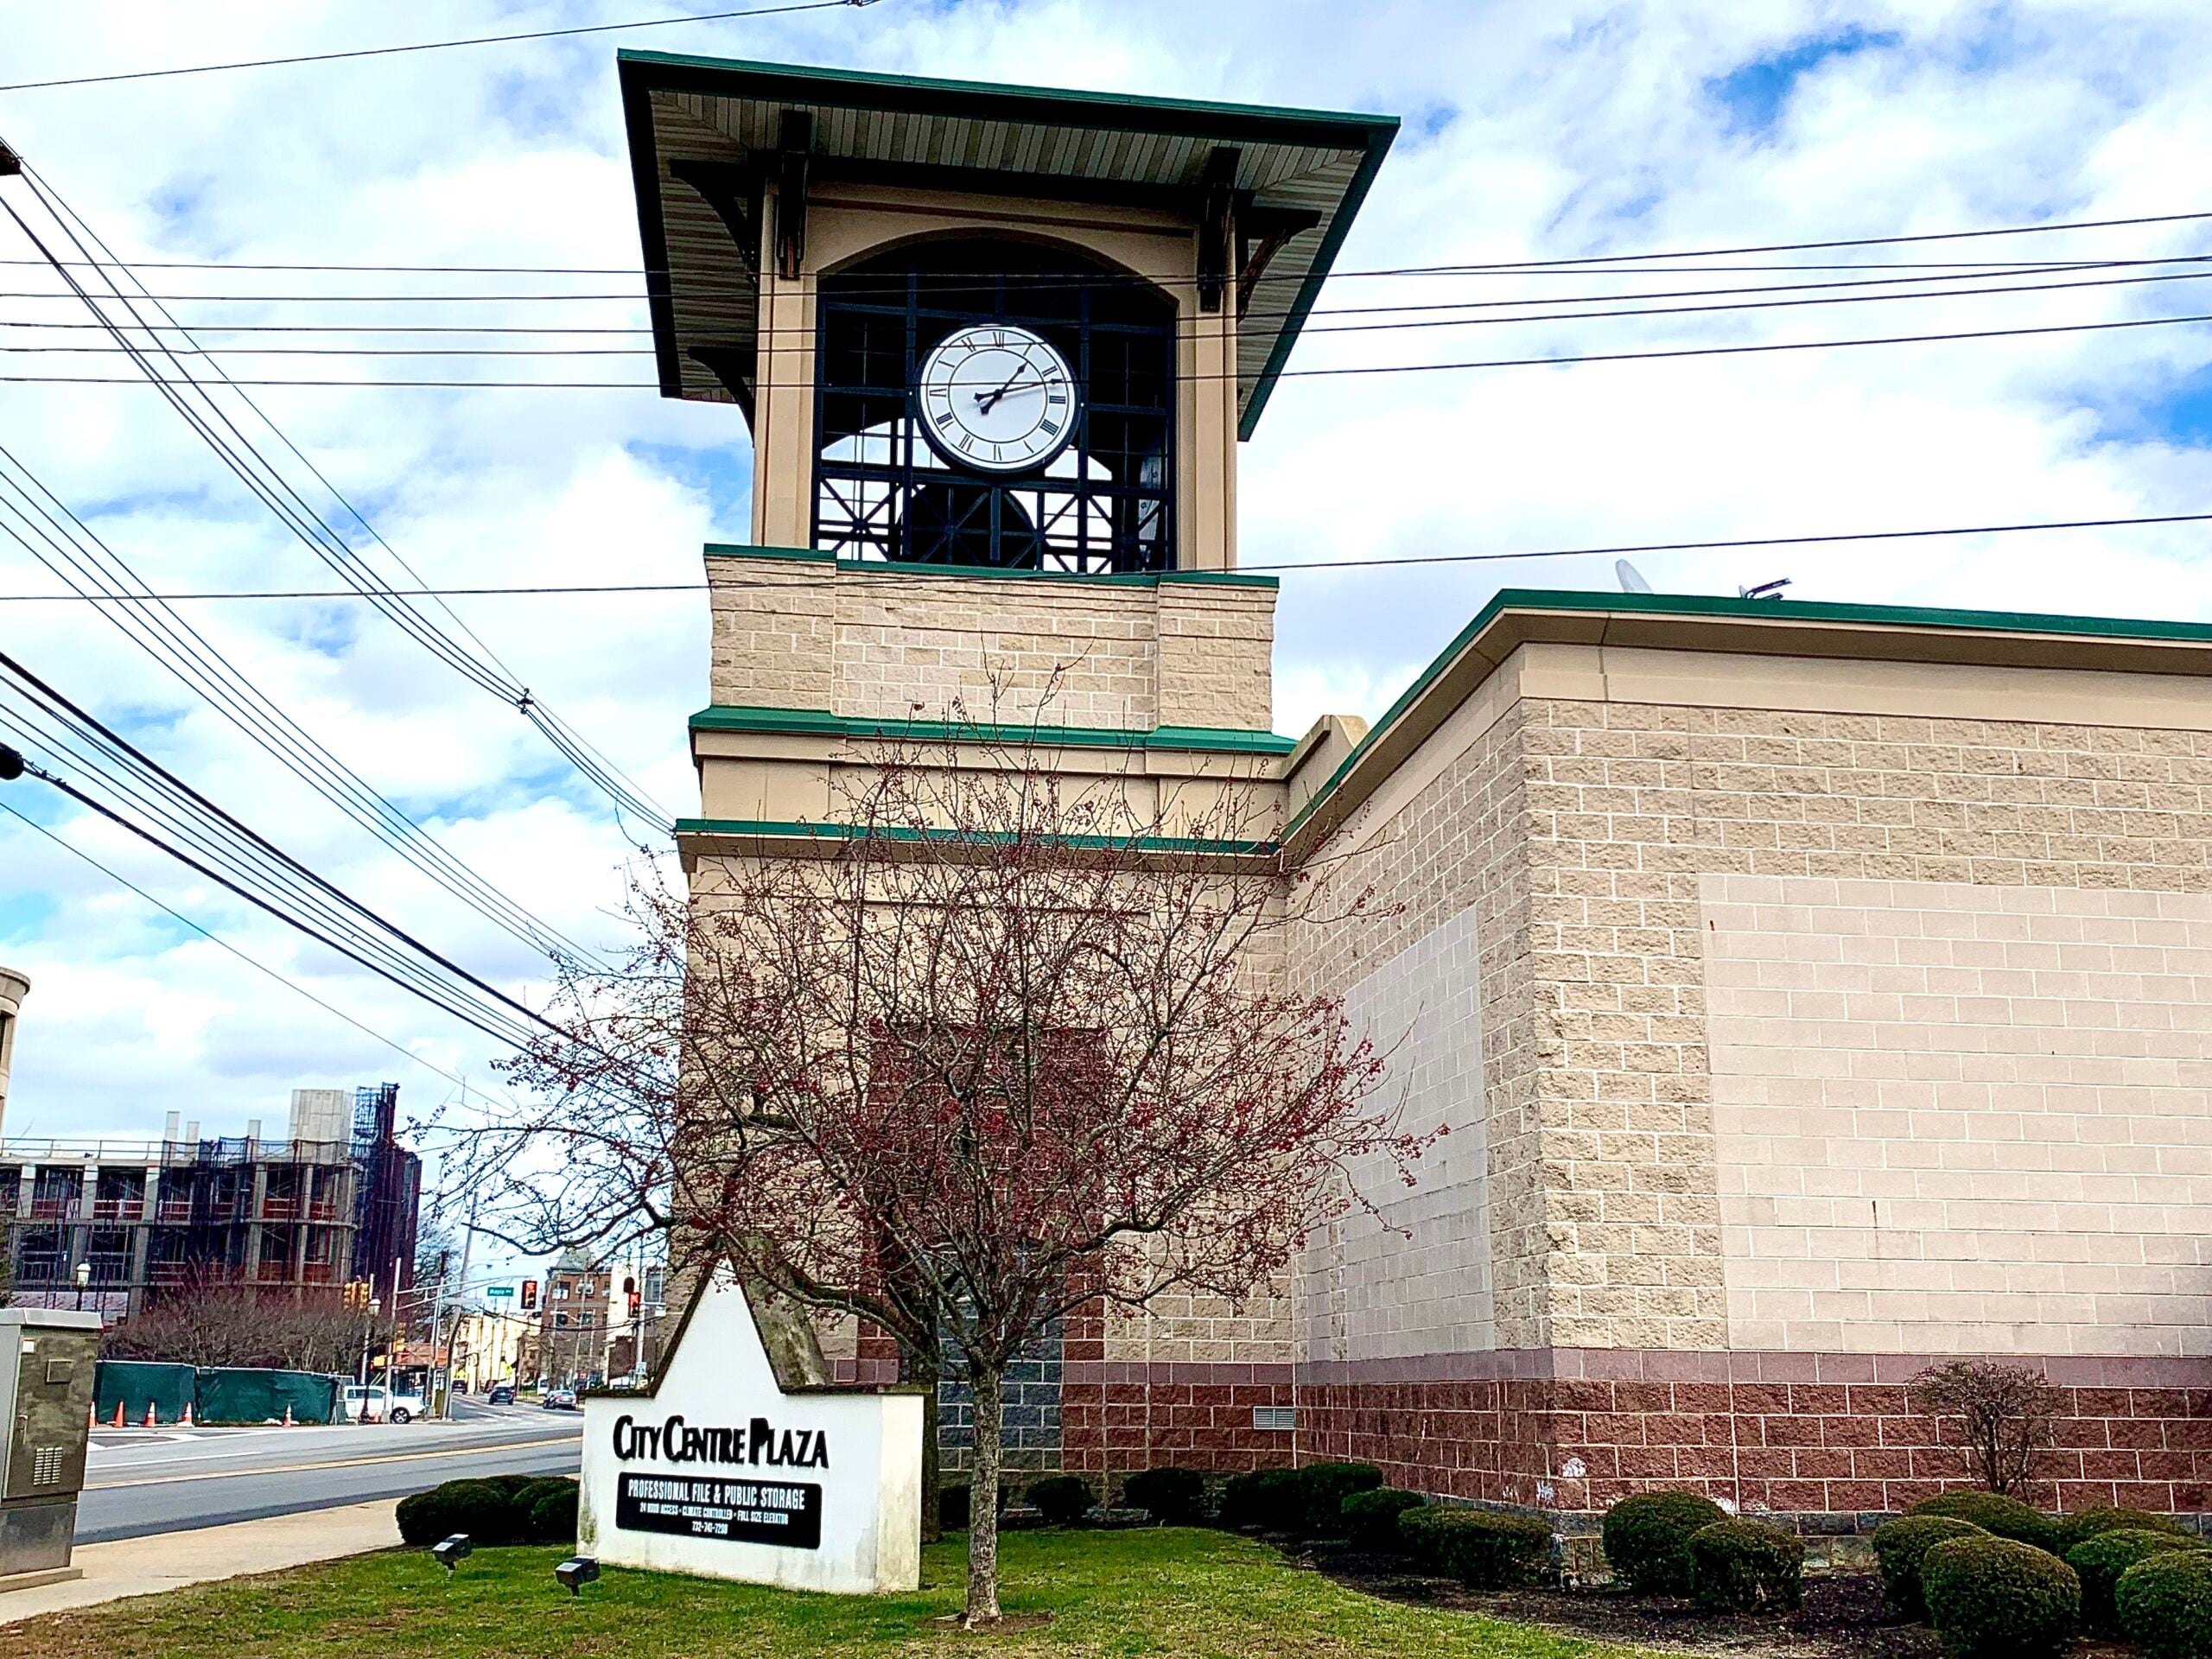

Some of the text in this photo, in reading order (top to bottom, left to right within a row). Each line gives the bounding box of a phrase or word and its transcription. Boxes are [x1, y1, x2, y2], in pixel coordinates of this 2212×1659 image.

[613, 1414, 829, 1469] CITY CENTRE PLAZA
[628, 1478, 805, 1510] PROFESSIONAL FILE & PUBLIC STORAGE
